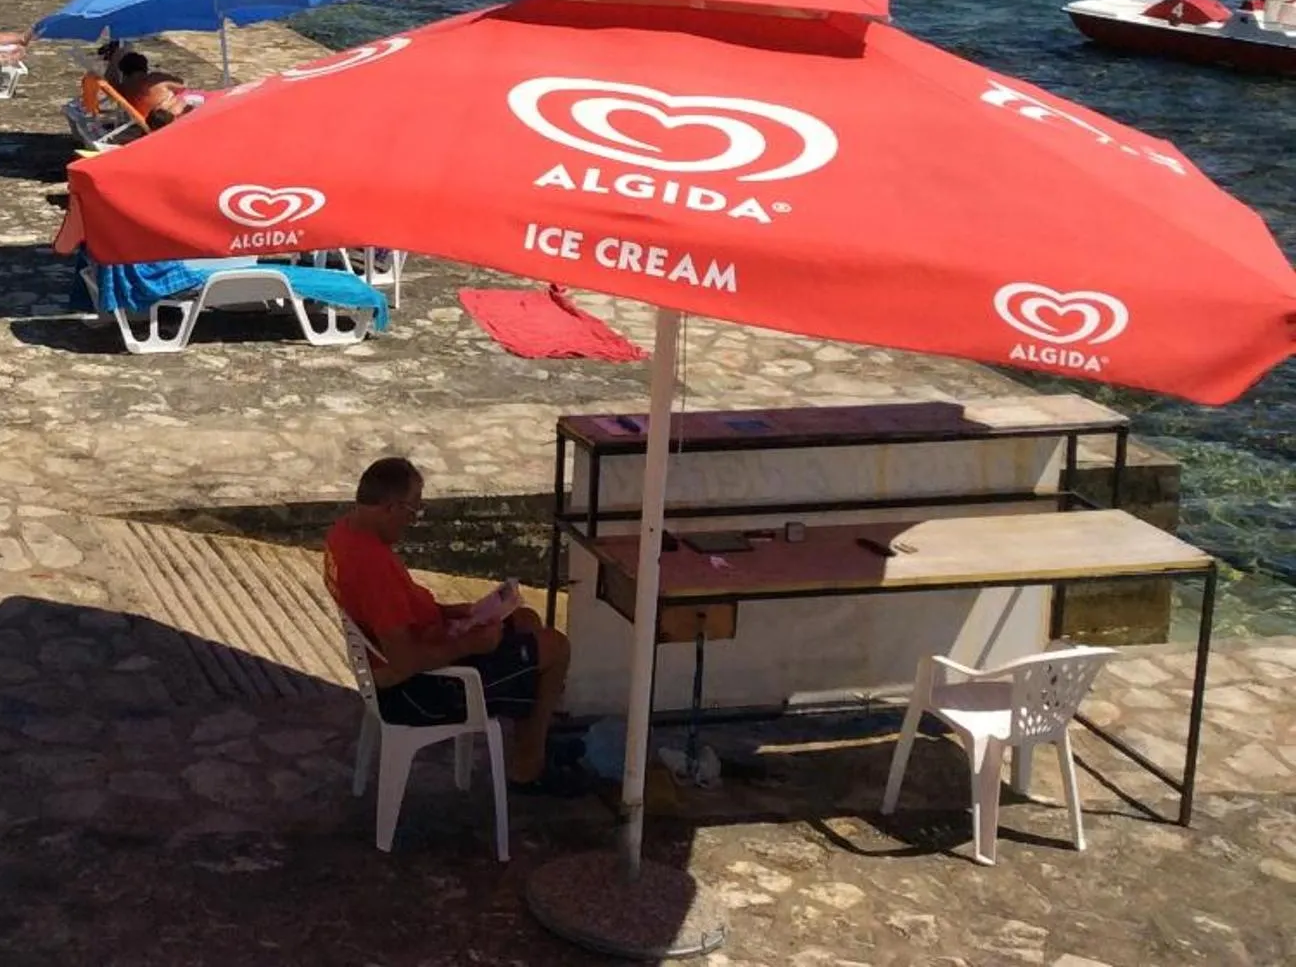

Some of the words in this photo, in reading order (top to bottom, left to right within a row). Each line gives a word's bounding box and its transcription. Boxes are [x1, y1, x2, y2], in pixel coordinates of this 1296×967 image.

[1171, 2, 1184, 18] 4
[533, 163, 773, 224] ALGIDA
[230, 230, 298, 250] ALGIDA
[523, 222, 584, 261] ICE
[594, 237, 738, 294] CREAM
[1009, 342, 1101, 373] ALGIDA
